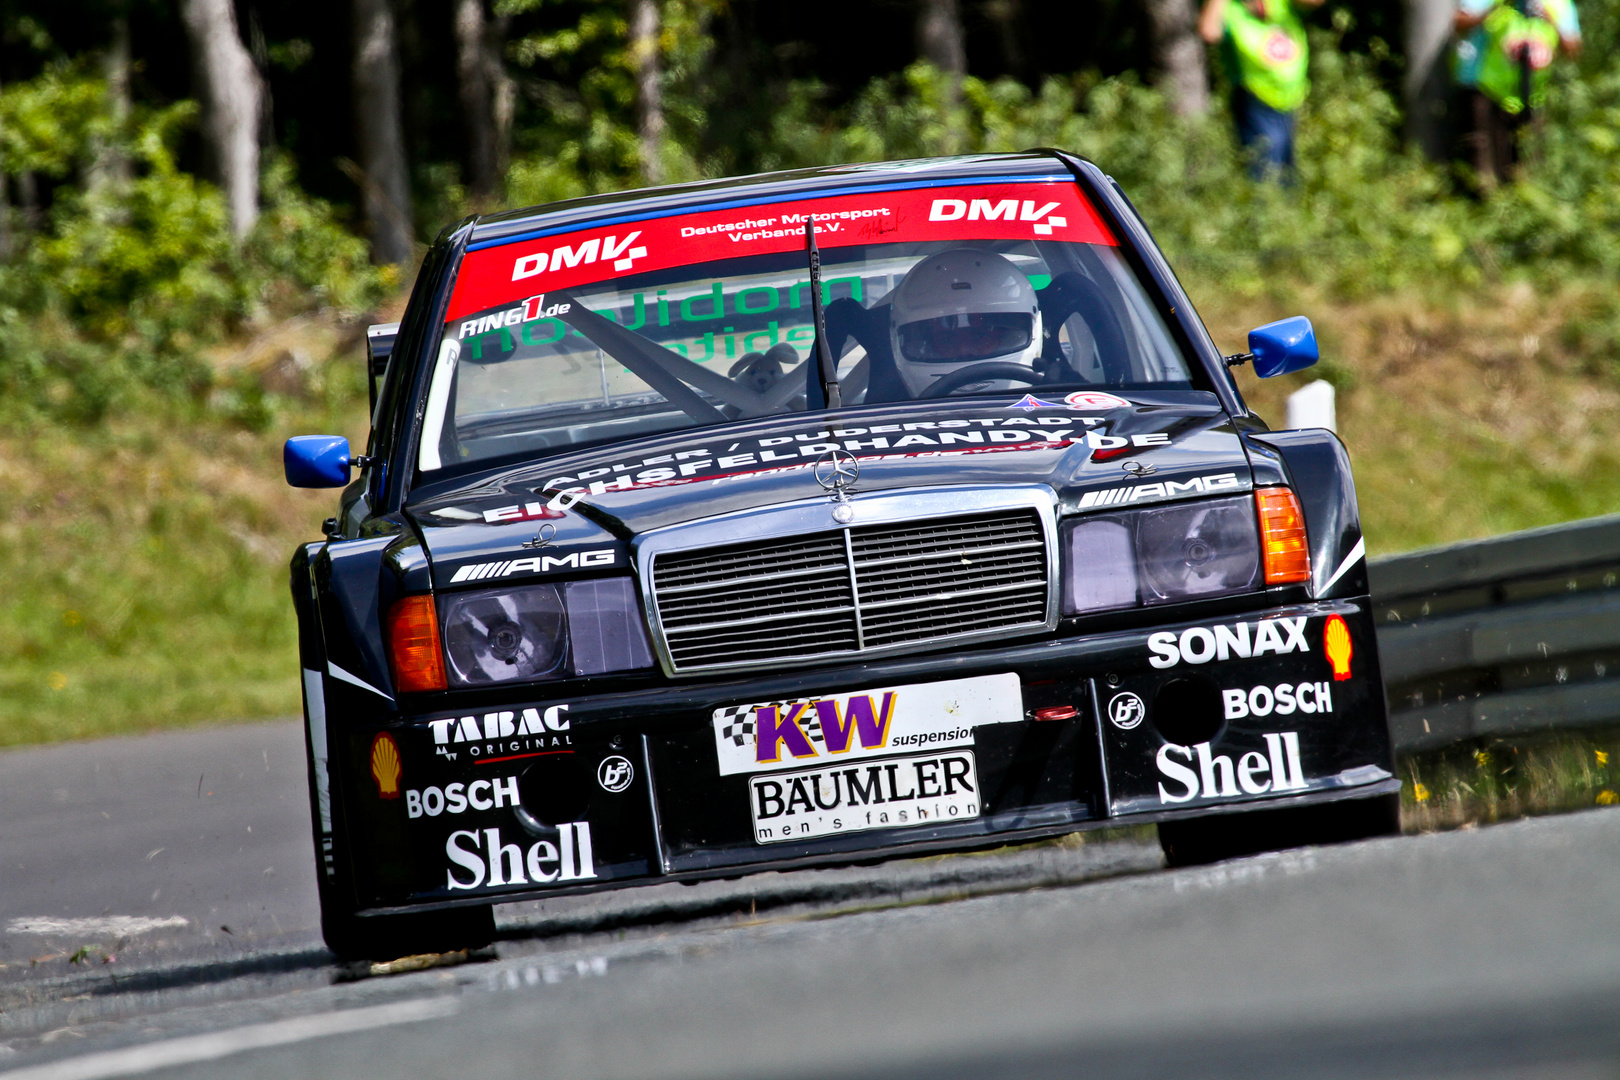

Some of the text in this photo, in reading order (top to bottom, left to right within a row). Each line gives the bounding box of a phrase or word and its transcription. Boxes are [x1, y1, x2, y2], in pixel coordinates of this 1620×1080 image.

[681, 217, 777, 238] Deutscher
[781, 207, 891, 227] Motorsport
[728, 225, 806, 243] Verband
[928, 199, 1064, 228] DMV
[511, 231, 645, 281] DMV
[458, 294, 572, 340] RING1.de
[482, 428, 1174, 523] EICHSFELDHANDY.DE
[541, 448, 712, 493] ADLER
[758, 416, 1105, 447] DUDERSTADT
[1129, 472, 1239, 499] AMG
[501, 548, 615, 577] AMG
[1147, 616, 1310, 669] SONAX
[1222, 681, 1333, 720] BOSCH
[428, 704, 570, 745] TABAC
[755, 691, 898, 764] KW
[470, 736, 573, 757] ORIGINAL
[1156, 731, 1310, 804] Shell
[406, 776, 521, 819] BOSCH
[754, 755, 975, 820] BÄUMLER
[758, 801, 977, 839] men's fashion
[445, 821, 598, 891] Shell
